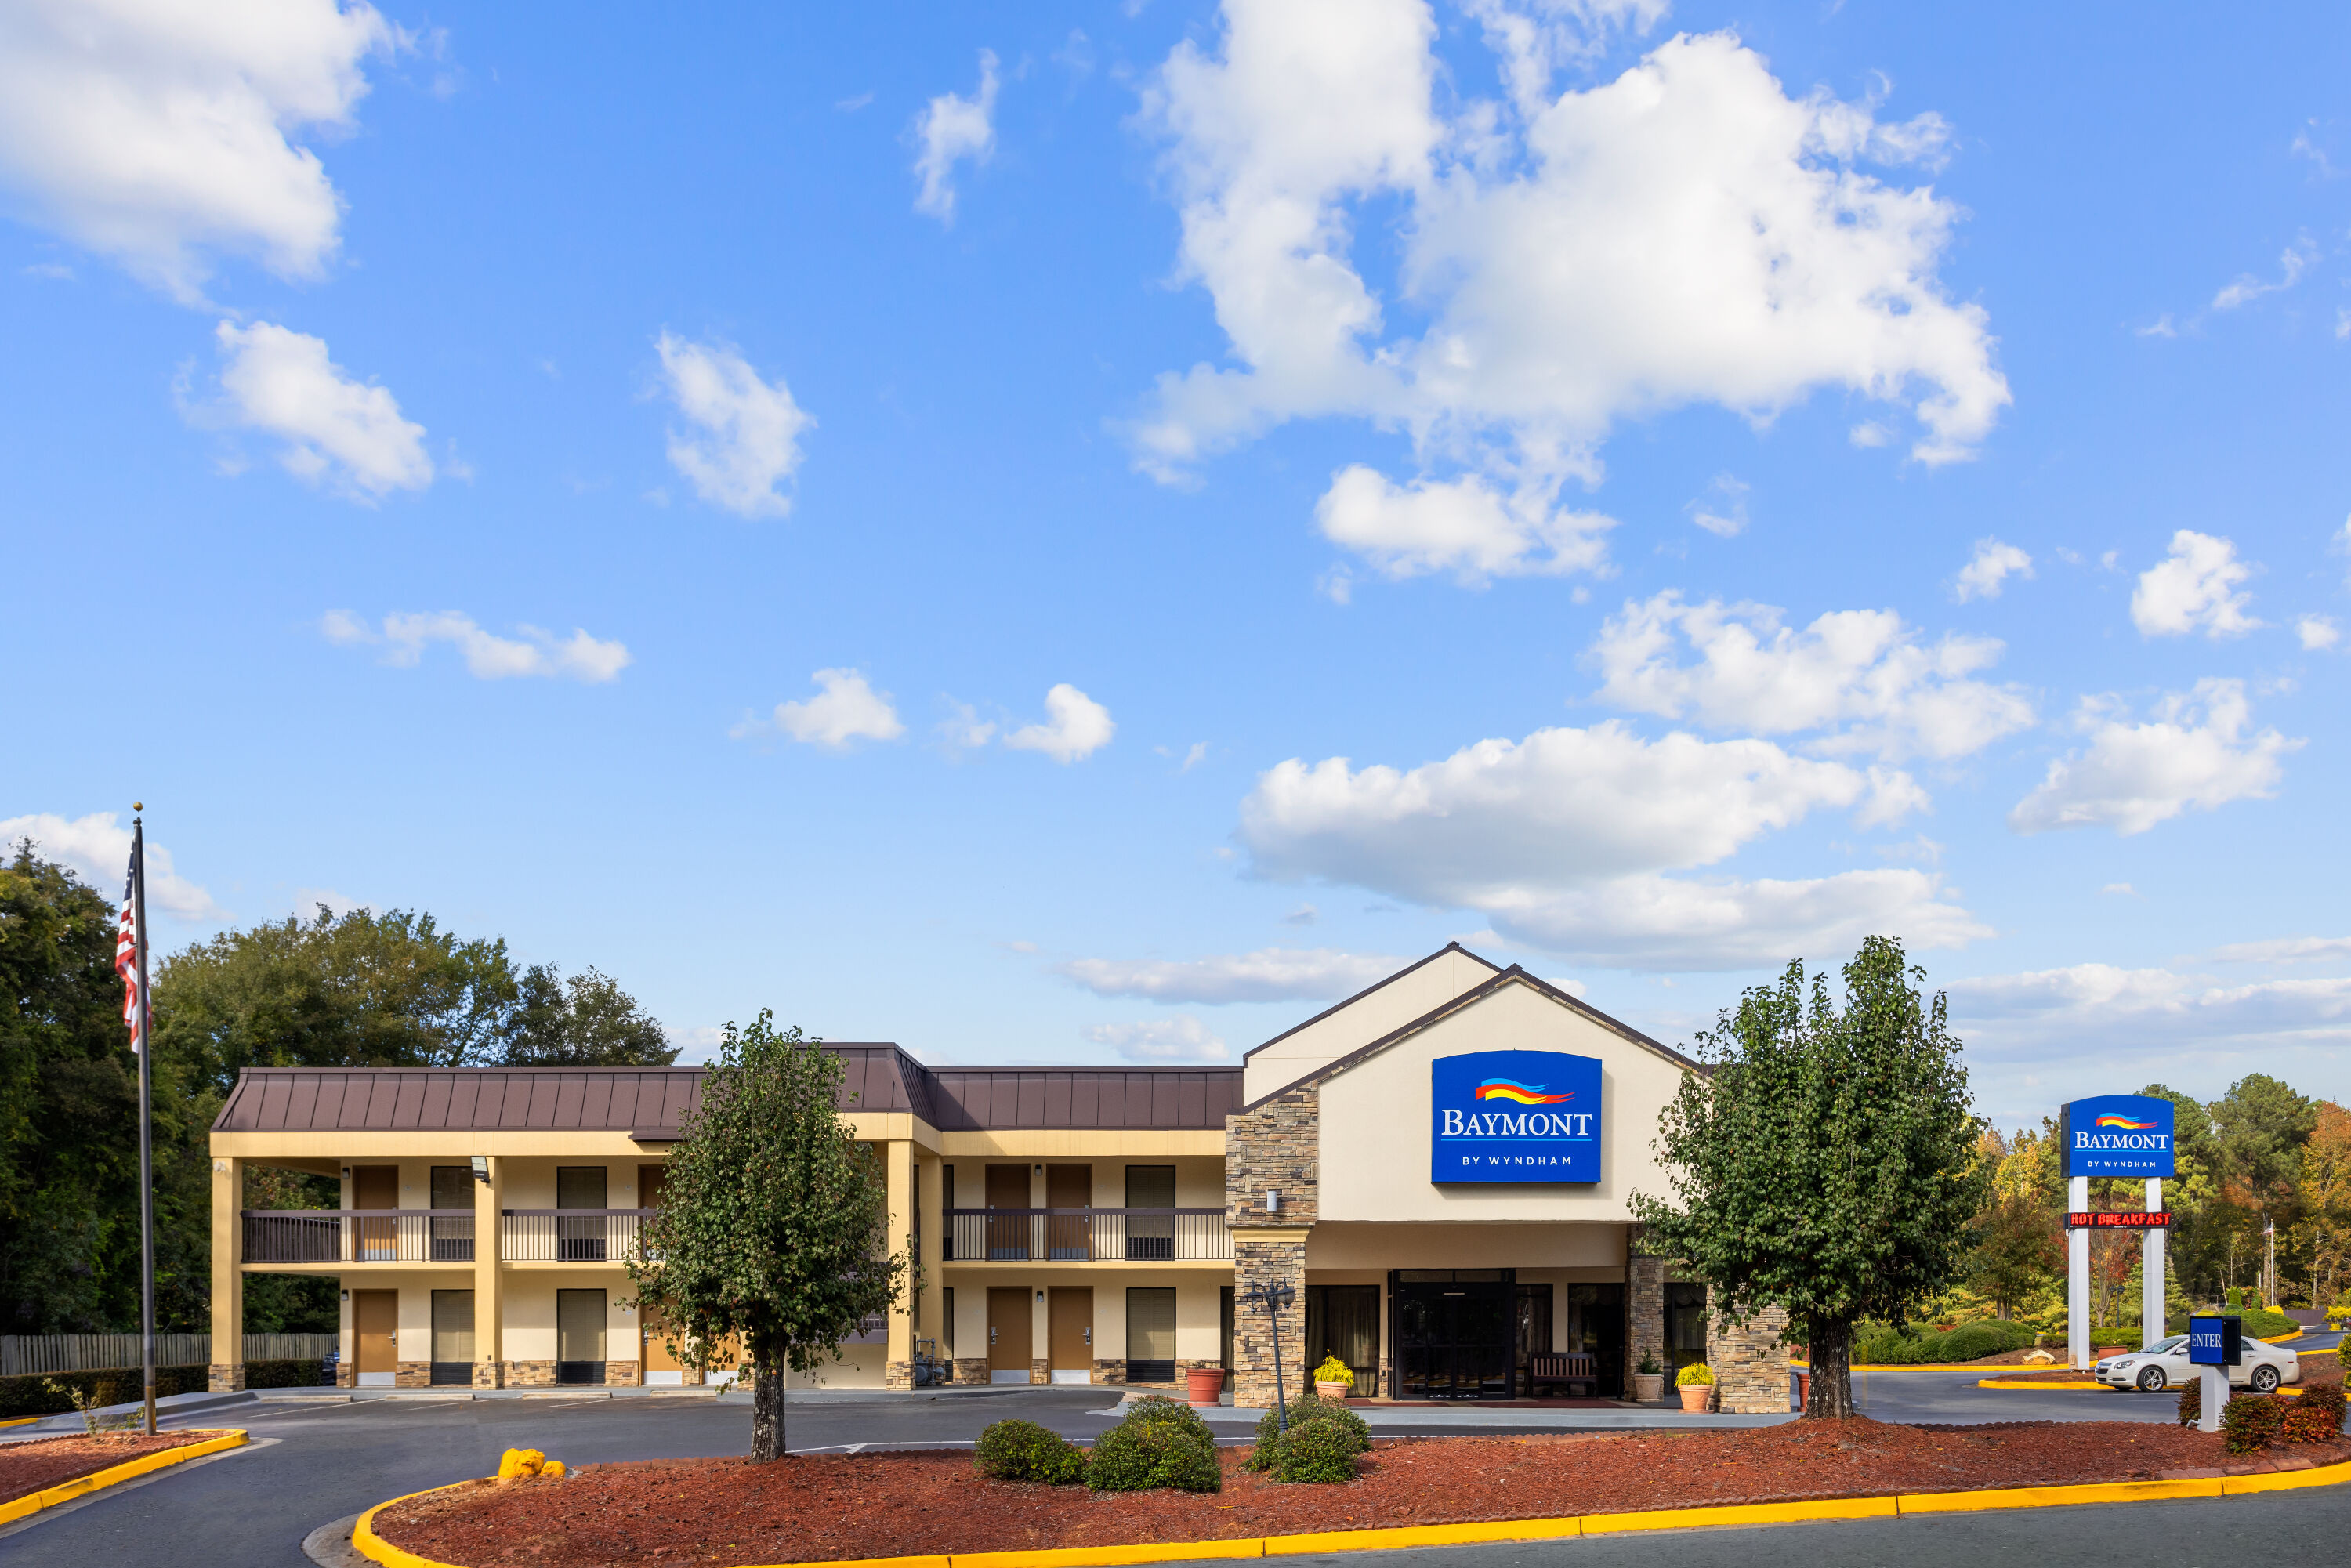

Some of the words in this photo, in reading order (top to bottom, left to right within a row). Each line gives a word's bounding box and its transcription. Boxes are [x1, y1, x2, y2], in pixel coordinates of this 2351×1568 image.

[1441, 1109, 1592, 1135] BAYMONT
[2075, 1132, 2169, 1149] BAYMONT
[1462, 1157, 1480, 1165] BY
[1489, 1157, 1571, 1165] WYNDHAM
[2070, 1213, 2095, 1225] HOT
[2097, 1213, 2171, 1226] BREAKFAST
[2192, 1334, 2222, 1348] ENTER
